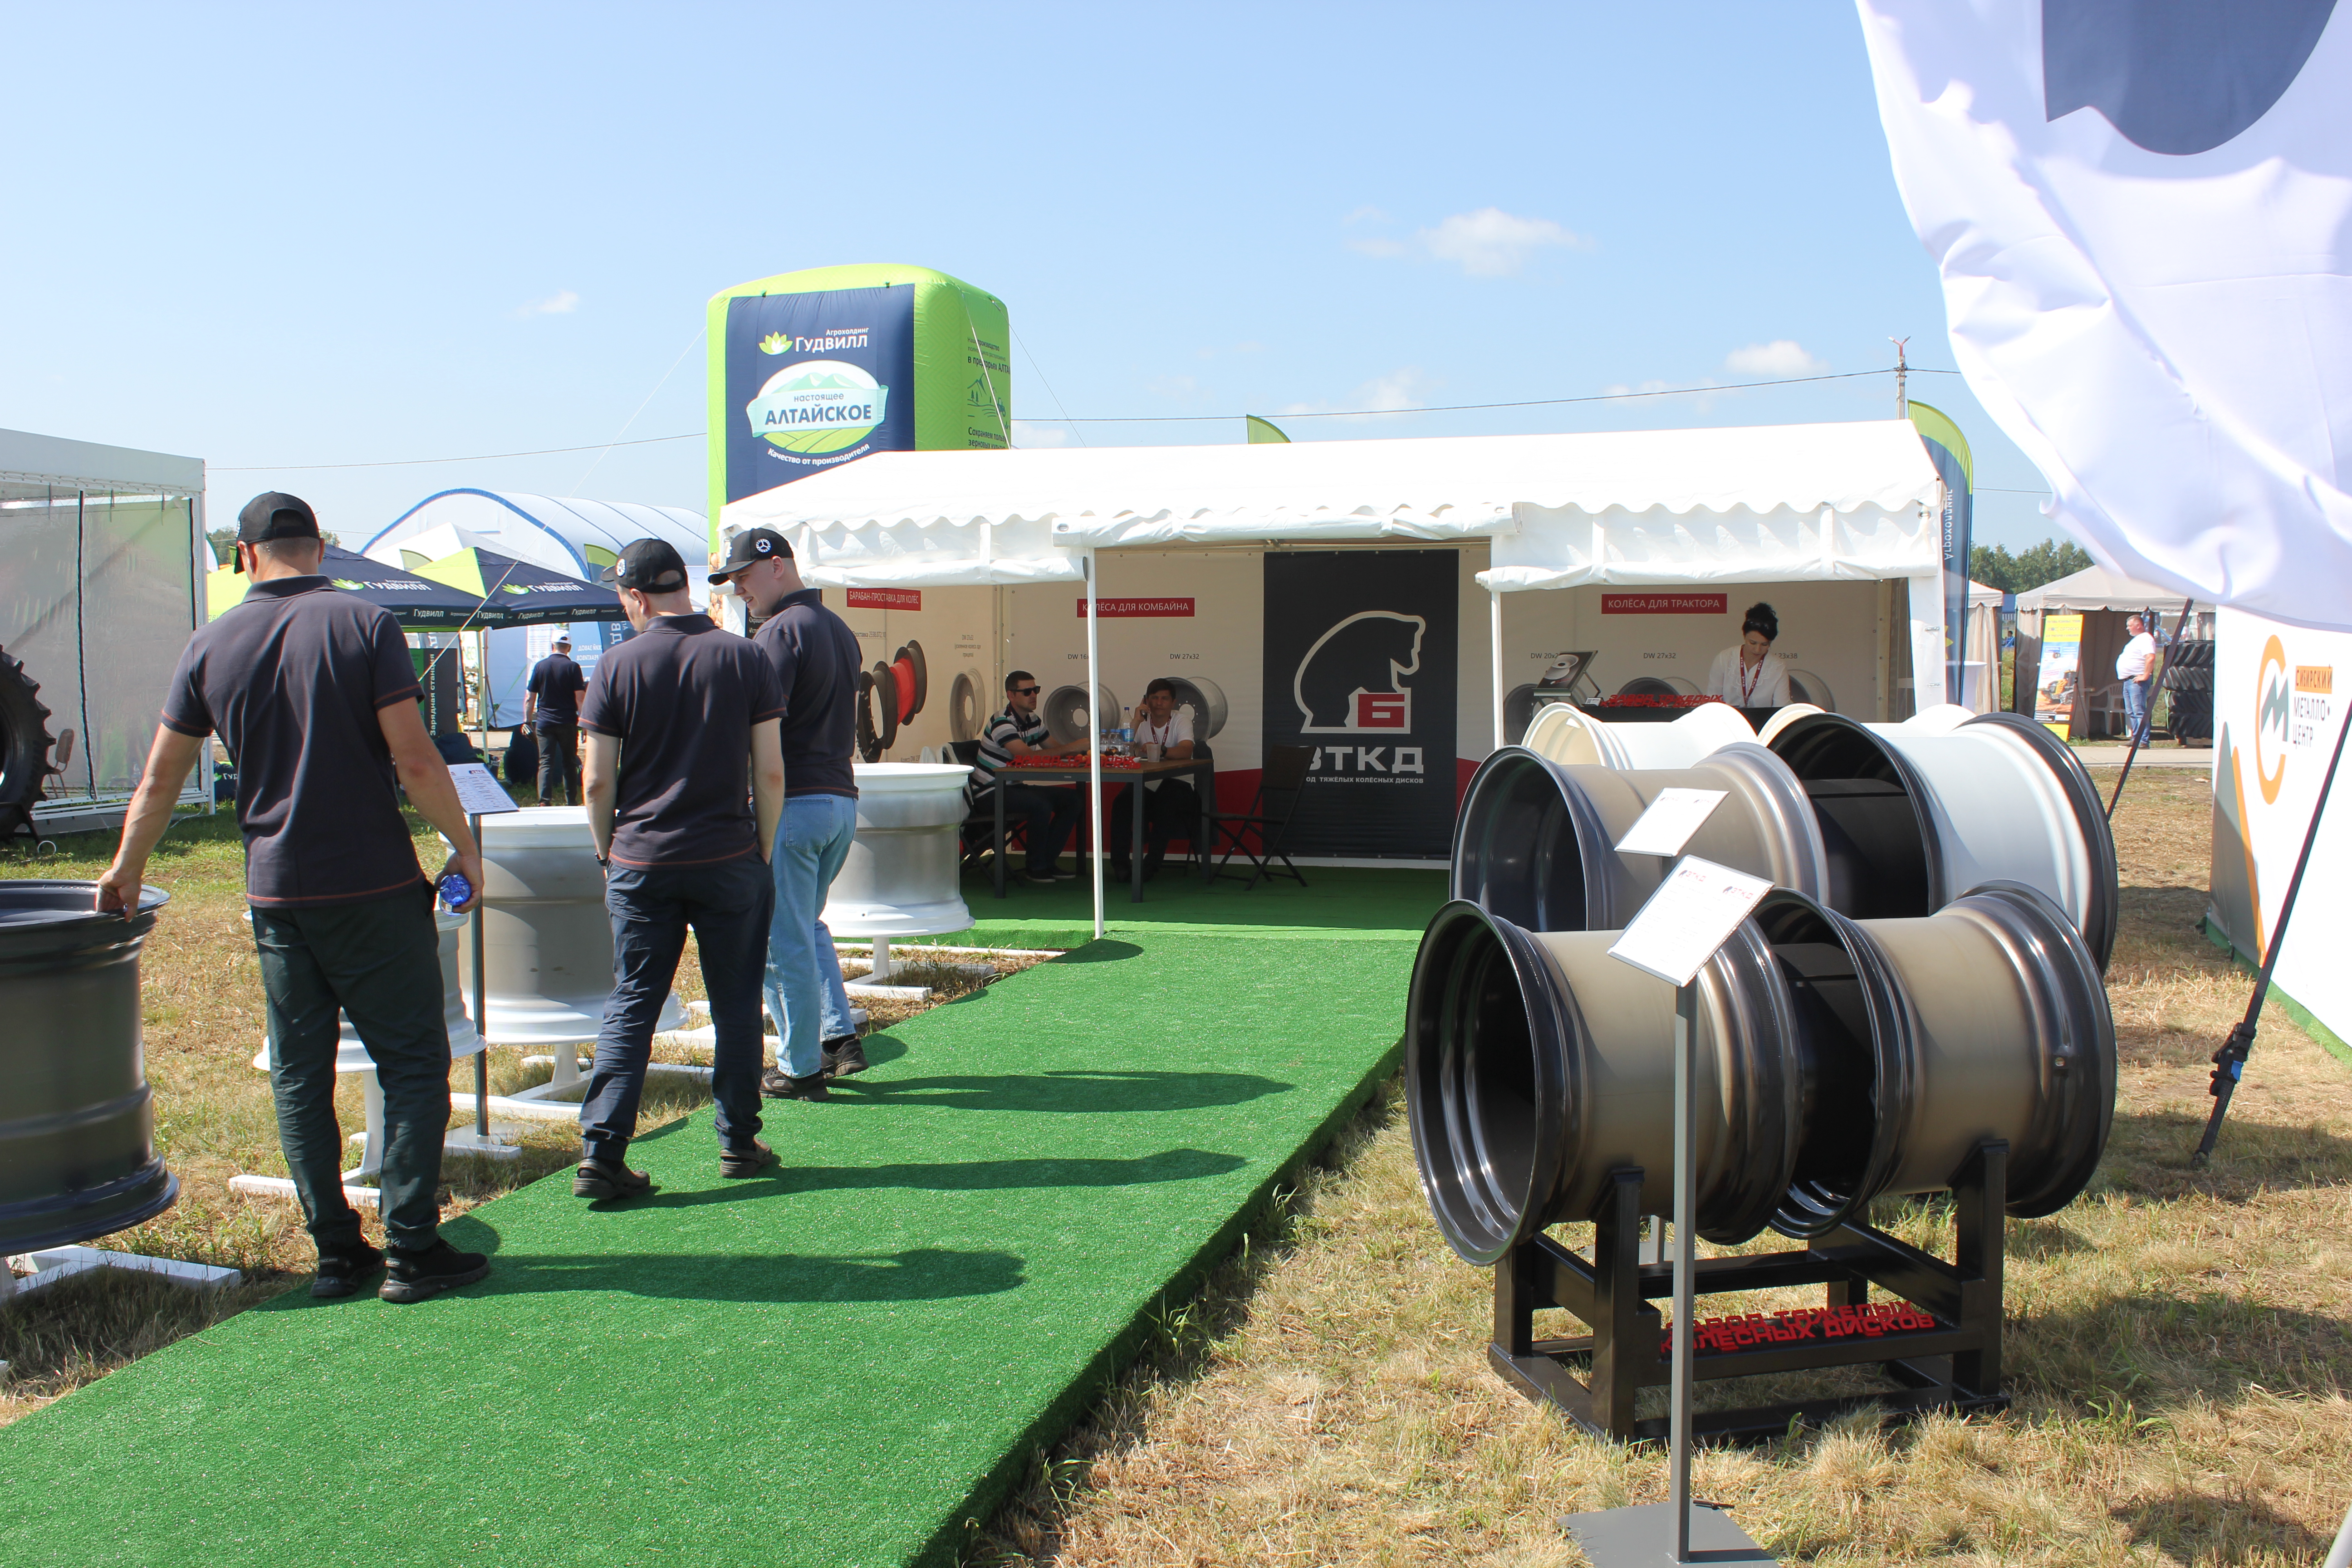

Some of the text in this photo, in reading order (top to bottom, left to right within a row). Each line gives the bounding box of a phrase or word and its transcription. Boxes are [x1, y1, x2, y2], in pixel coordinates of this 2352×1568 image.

[826, 328, 869, 337] Агрохолдинг
[794, 393, 844, 402] настоящее
[764, 403, 872, 425] АЛТАЙСКОЕ
[768, 448, 801, 464] Качество
[812, 443, 870, 466] производителя
[849, 591, 896, 603] БАРАБАН-ПРОСТАВКА
[897, 594, 906, 604] ДЛЯ
[1608, 599, 1720, 609] КОЛЁСА ДЛЯ ТРАКТОРА
[1083, 601, 1189, 612] КЛЁСА ДЛЯ КОМБАЙНА
[2296, 664, 2332, 689] СИБИРСКИЙ
[2293, 723, 2313, 750] ЦЕНТР
[1661, 1313, 1936, 1353] КЛЕСНЫХ ДИСКОВ
